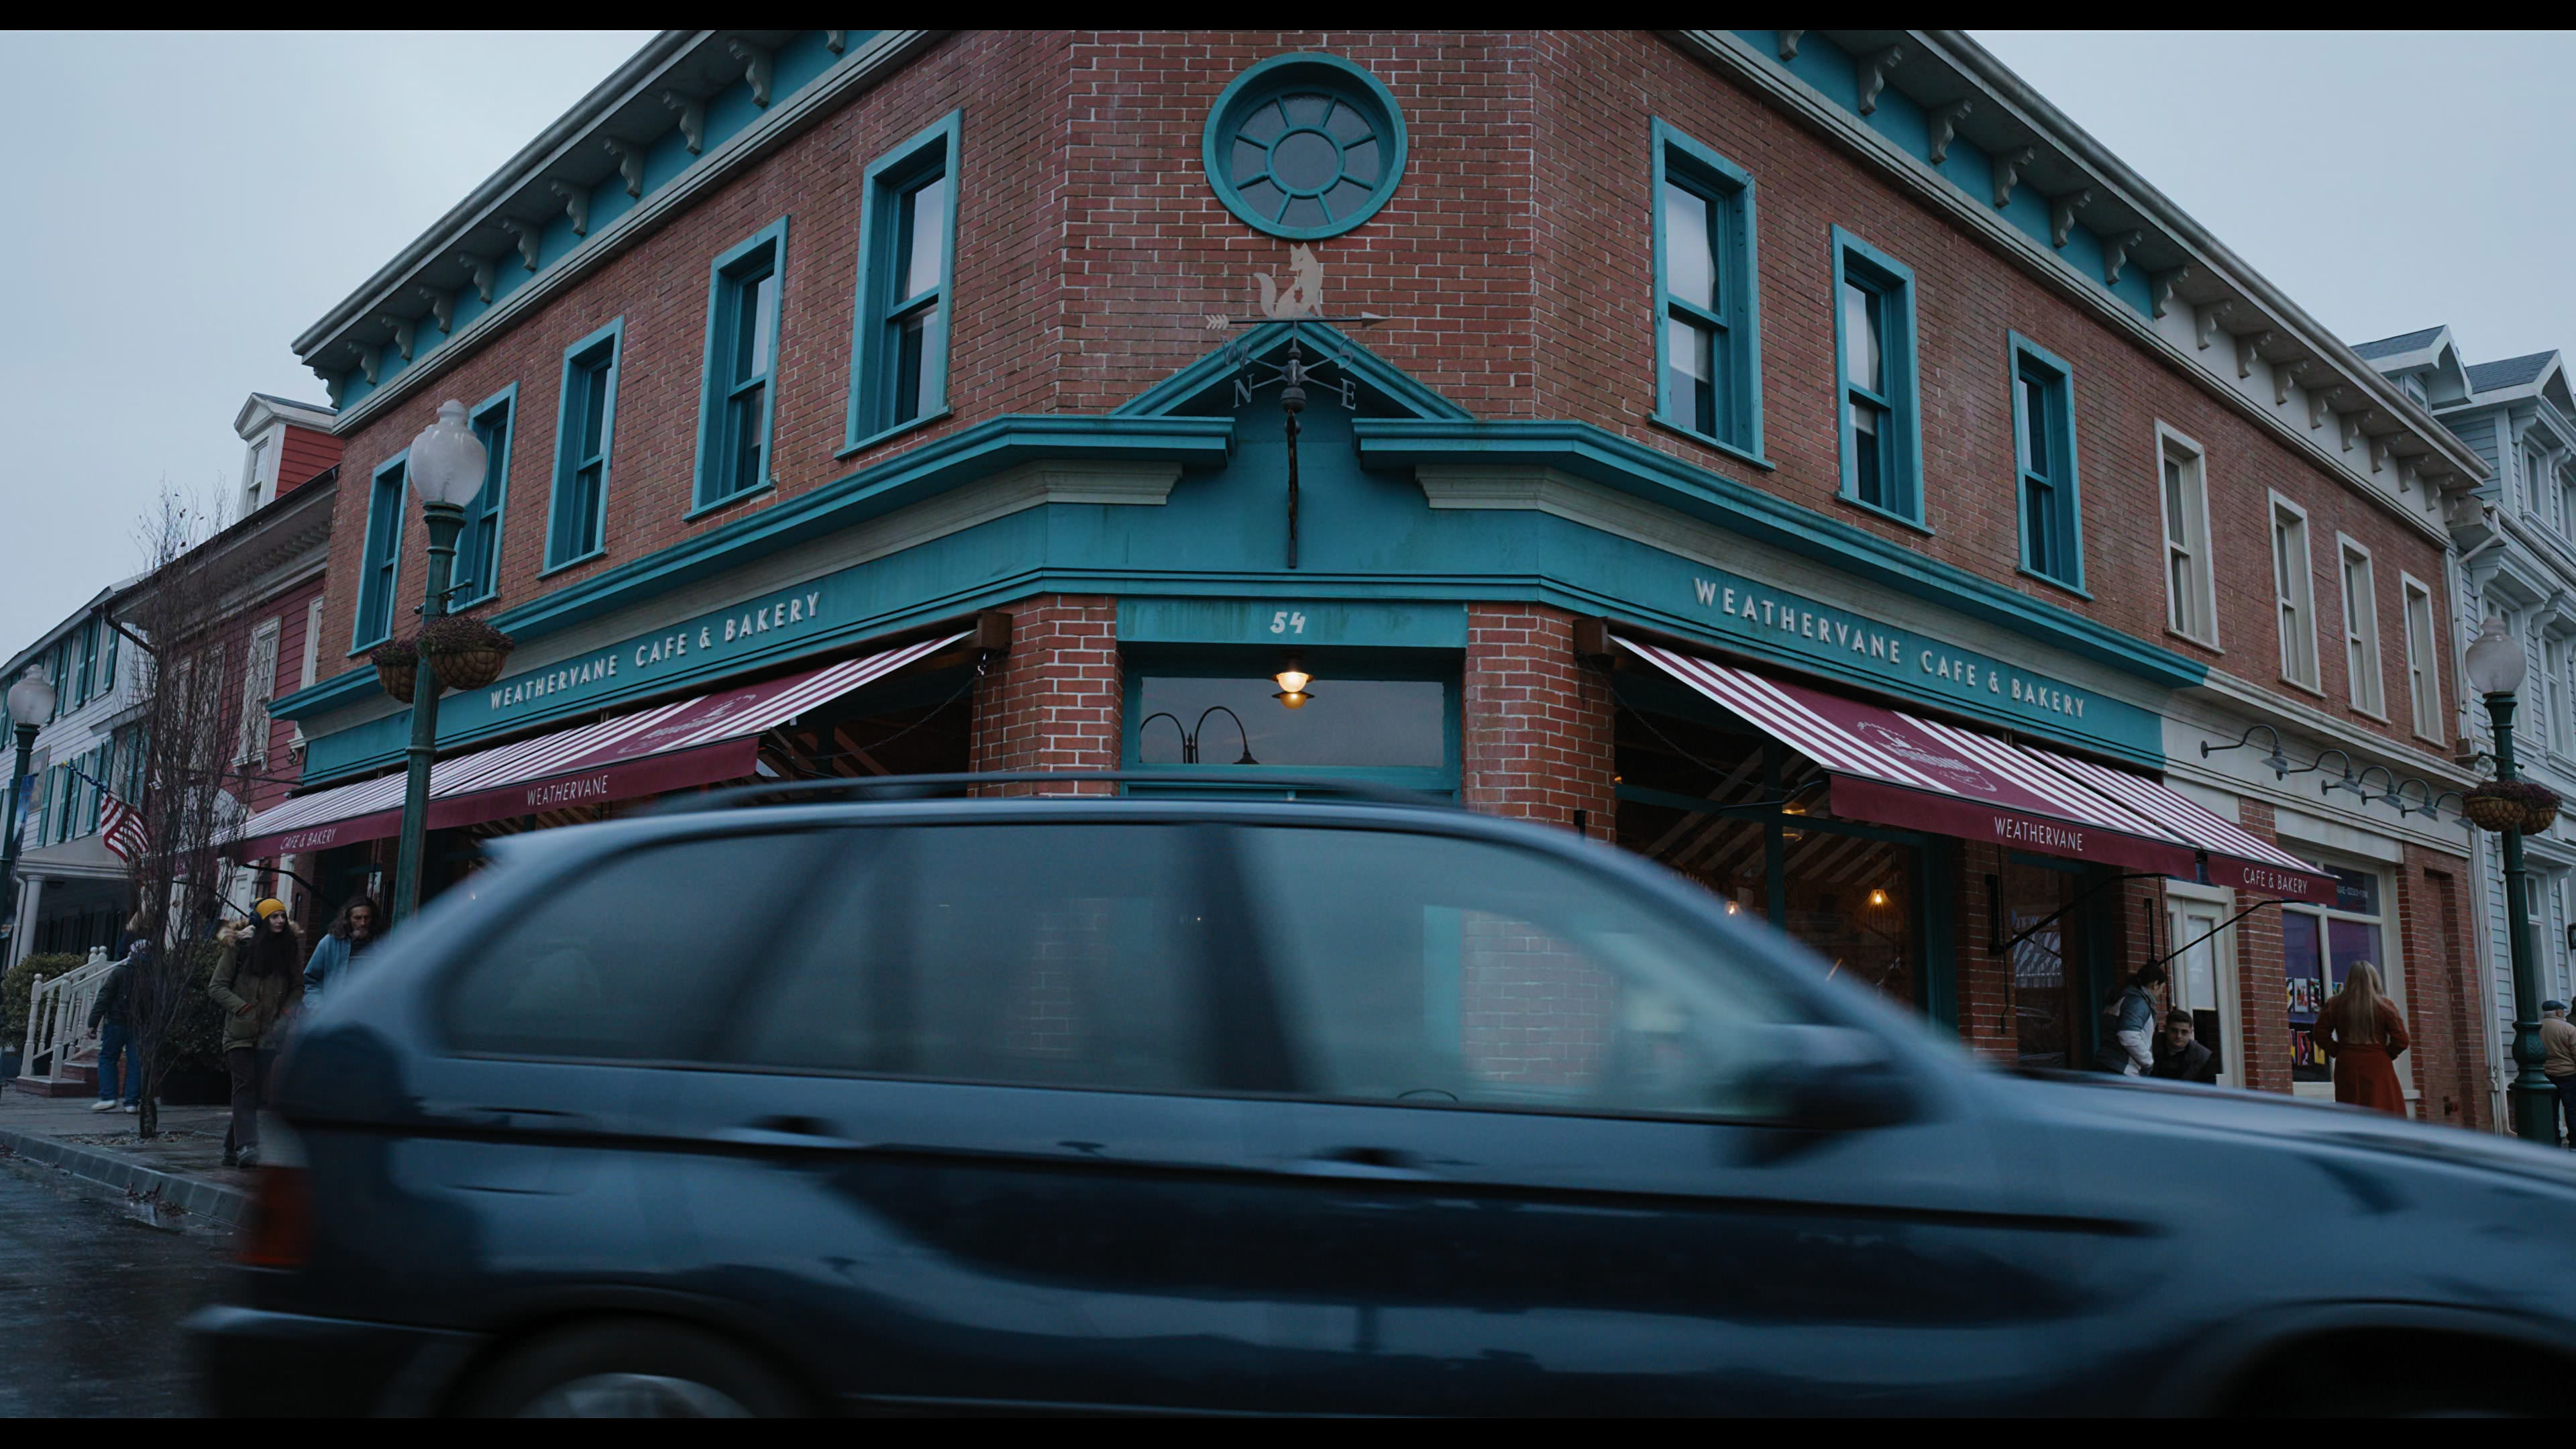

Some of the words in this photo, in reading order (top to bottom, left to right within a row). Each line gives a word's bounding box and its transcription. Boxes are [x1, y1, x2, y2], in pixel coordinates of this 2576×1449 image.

[1233, 374, 1254, 408] N
[1341, 378, 1356, 410] E
[1270, 612, 1305, 633] 54
[490, 655, 617, 709] WEATHERVANE
[636, 633, 687, 667] CAFE
[700, 627, 712, 649] &
[725, 592, 820, 641] BAKERY
[1694, 577, 1900, 663] WEATHERVANE
[1921, 651, 1976, 686] CAFE
[1988, 672, 2000, 694] &
[2011, 678, 2084, 717] BAKERY
[527, 775, 608, 806] WEATHERVANE
[280, 835, 300, 850] CAFE
[299, 834, 307, 847] &
[307, 828, 337, 847] BAKERY
[1994, 816, 2083, 851] WEATHERVANE
[2243, 867, 2265, 887] CAFE
[2269, 873, 2274, 888] &
[2277, 875, 2308, 894] BAKERY
